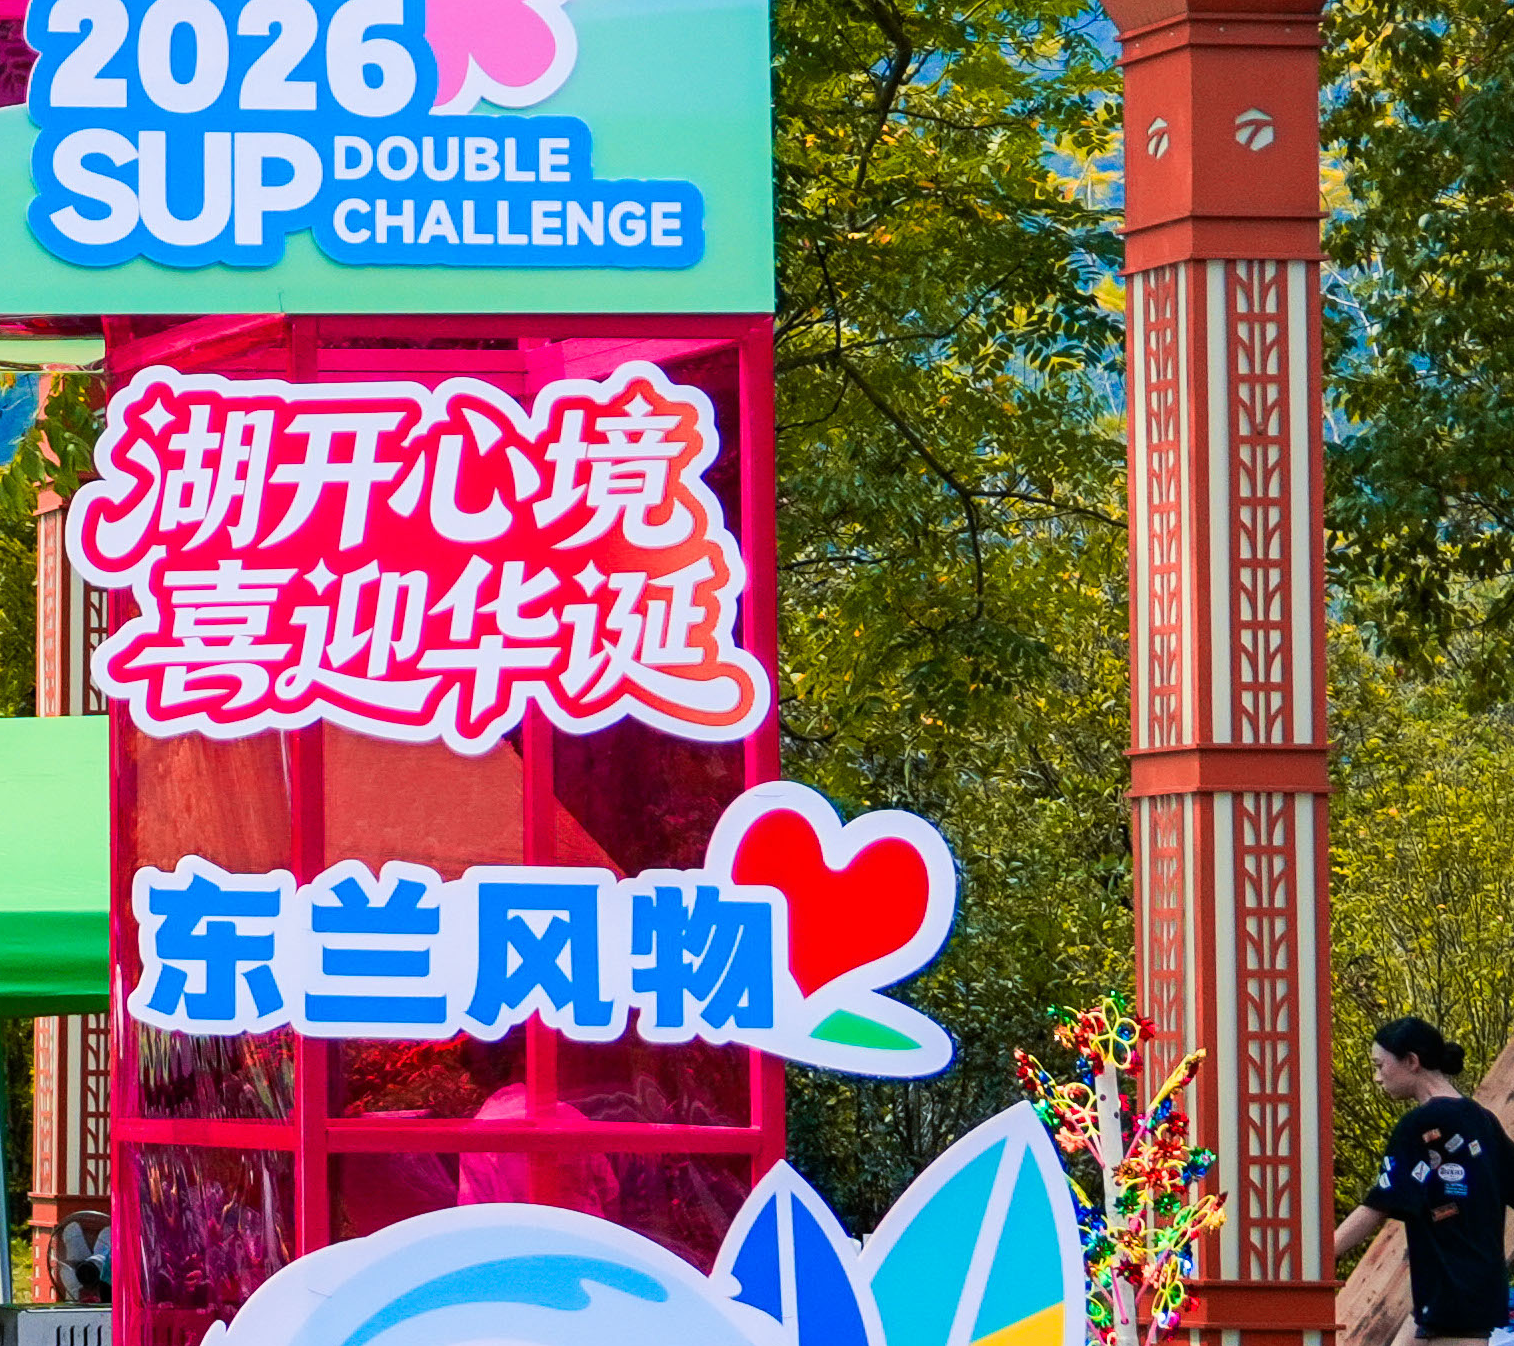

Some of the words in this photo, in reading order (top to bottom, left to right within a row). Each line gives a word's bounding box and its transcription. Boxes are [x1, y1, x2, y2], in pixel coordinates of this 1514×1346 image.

[50, 129, 323, 245] SUP
[332, 199, 682, 247] CHALLENGE
[334, 135, 570, 182] DOUBLE
[96, 395, 697, 555] 湖开心境
[114, 557, 742, 725] 喜迎华诞
[144, 875, 773, 1029] 东兰风物
